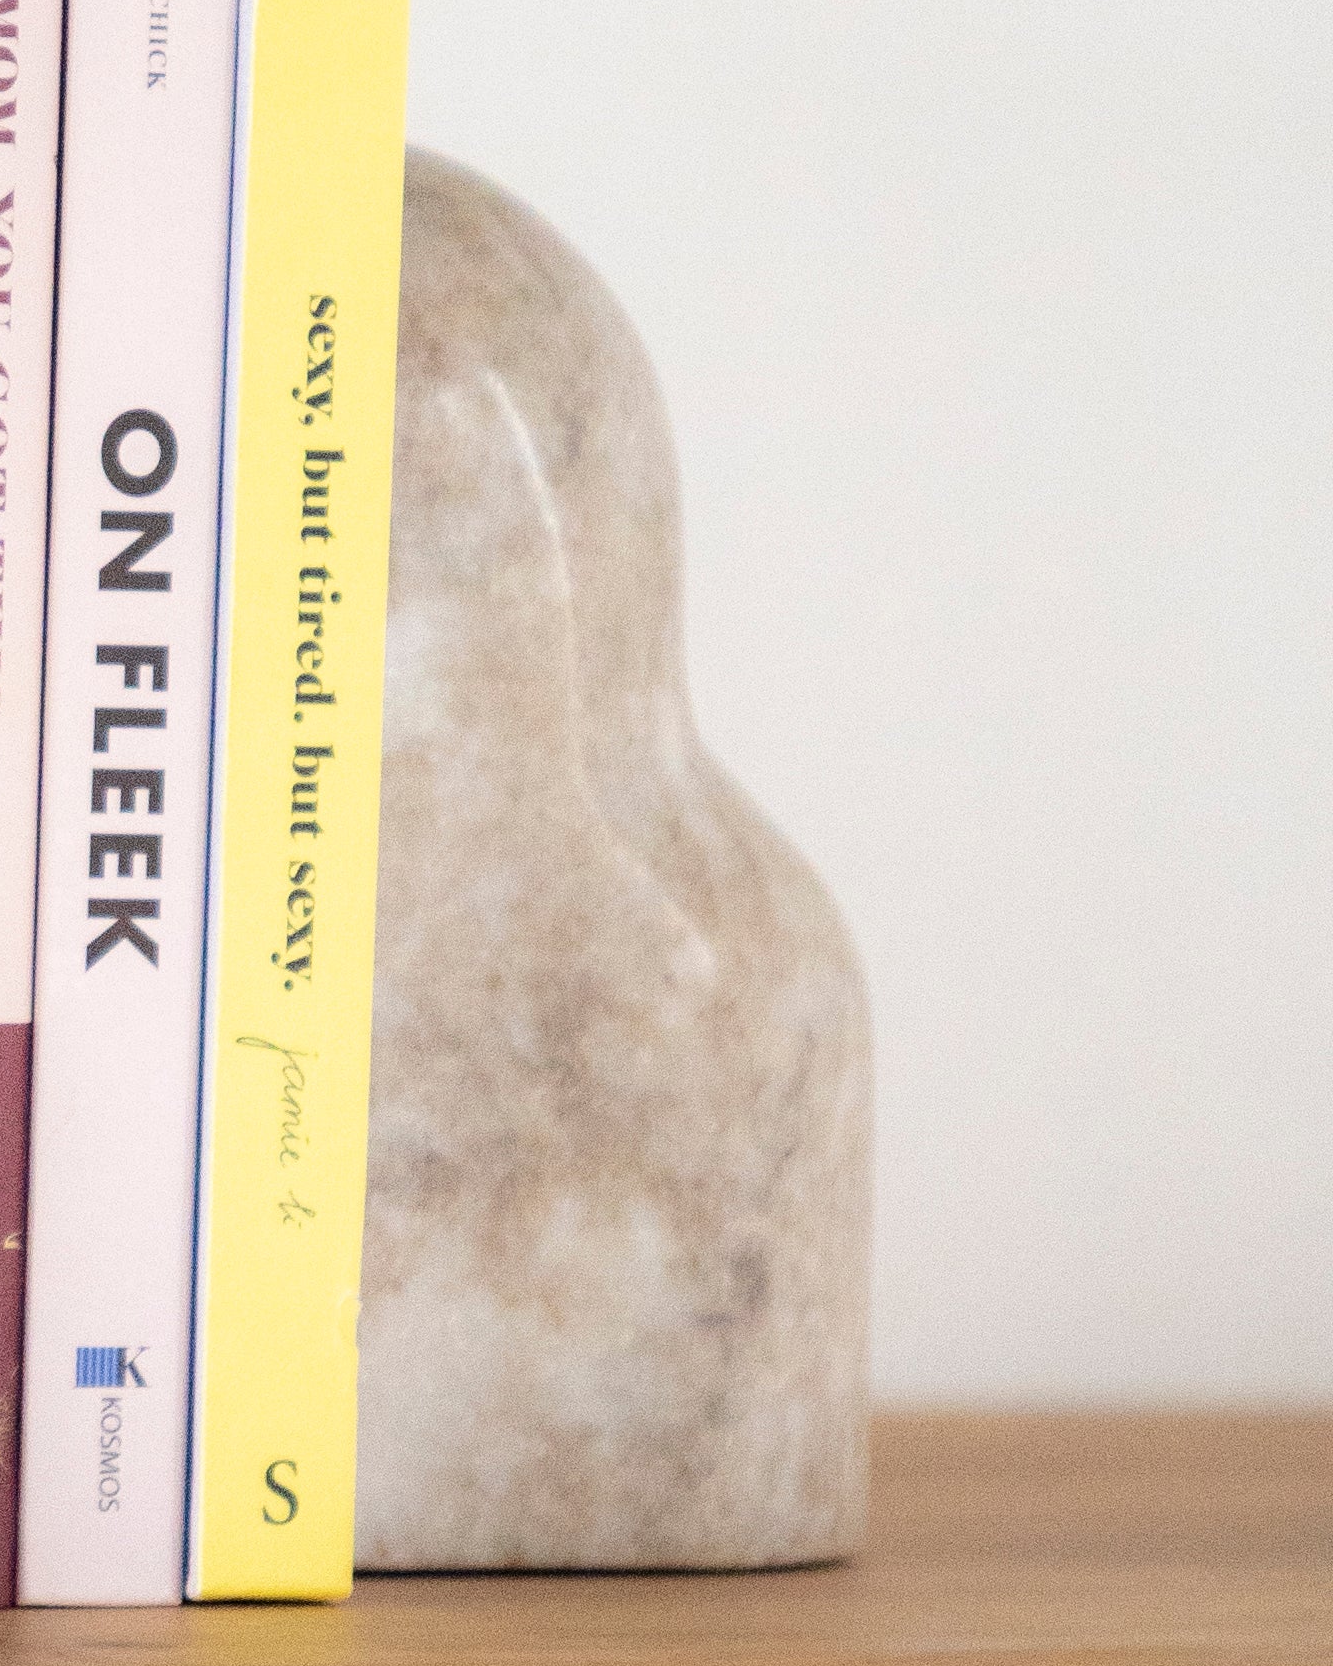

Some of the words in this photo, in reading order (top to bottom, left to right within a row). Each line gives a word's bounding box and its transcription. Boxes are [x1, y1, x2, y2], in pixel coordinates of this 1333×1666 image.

[291, 296, 334, 426] sexy,
[98, 408, 178, 592] ON
[300, 450, 344, 540] but
[293, 567, 341, 722] tired.
[85, 644, 169, 970] FLEEK
[289, 746, 334, 835] but
[270, 862, 313, 990] sexy.
[233, 1033, 319, 1165] jamie
[97, 1396, 122, 1513] KOSMOS
[263, 1462, 298, 1524] S
